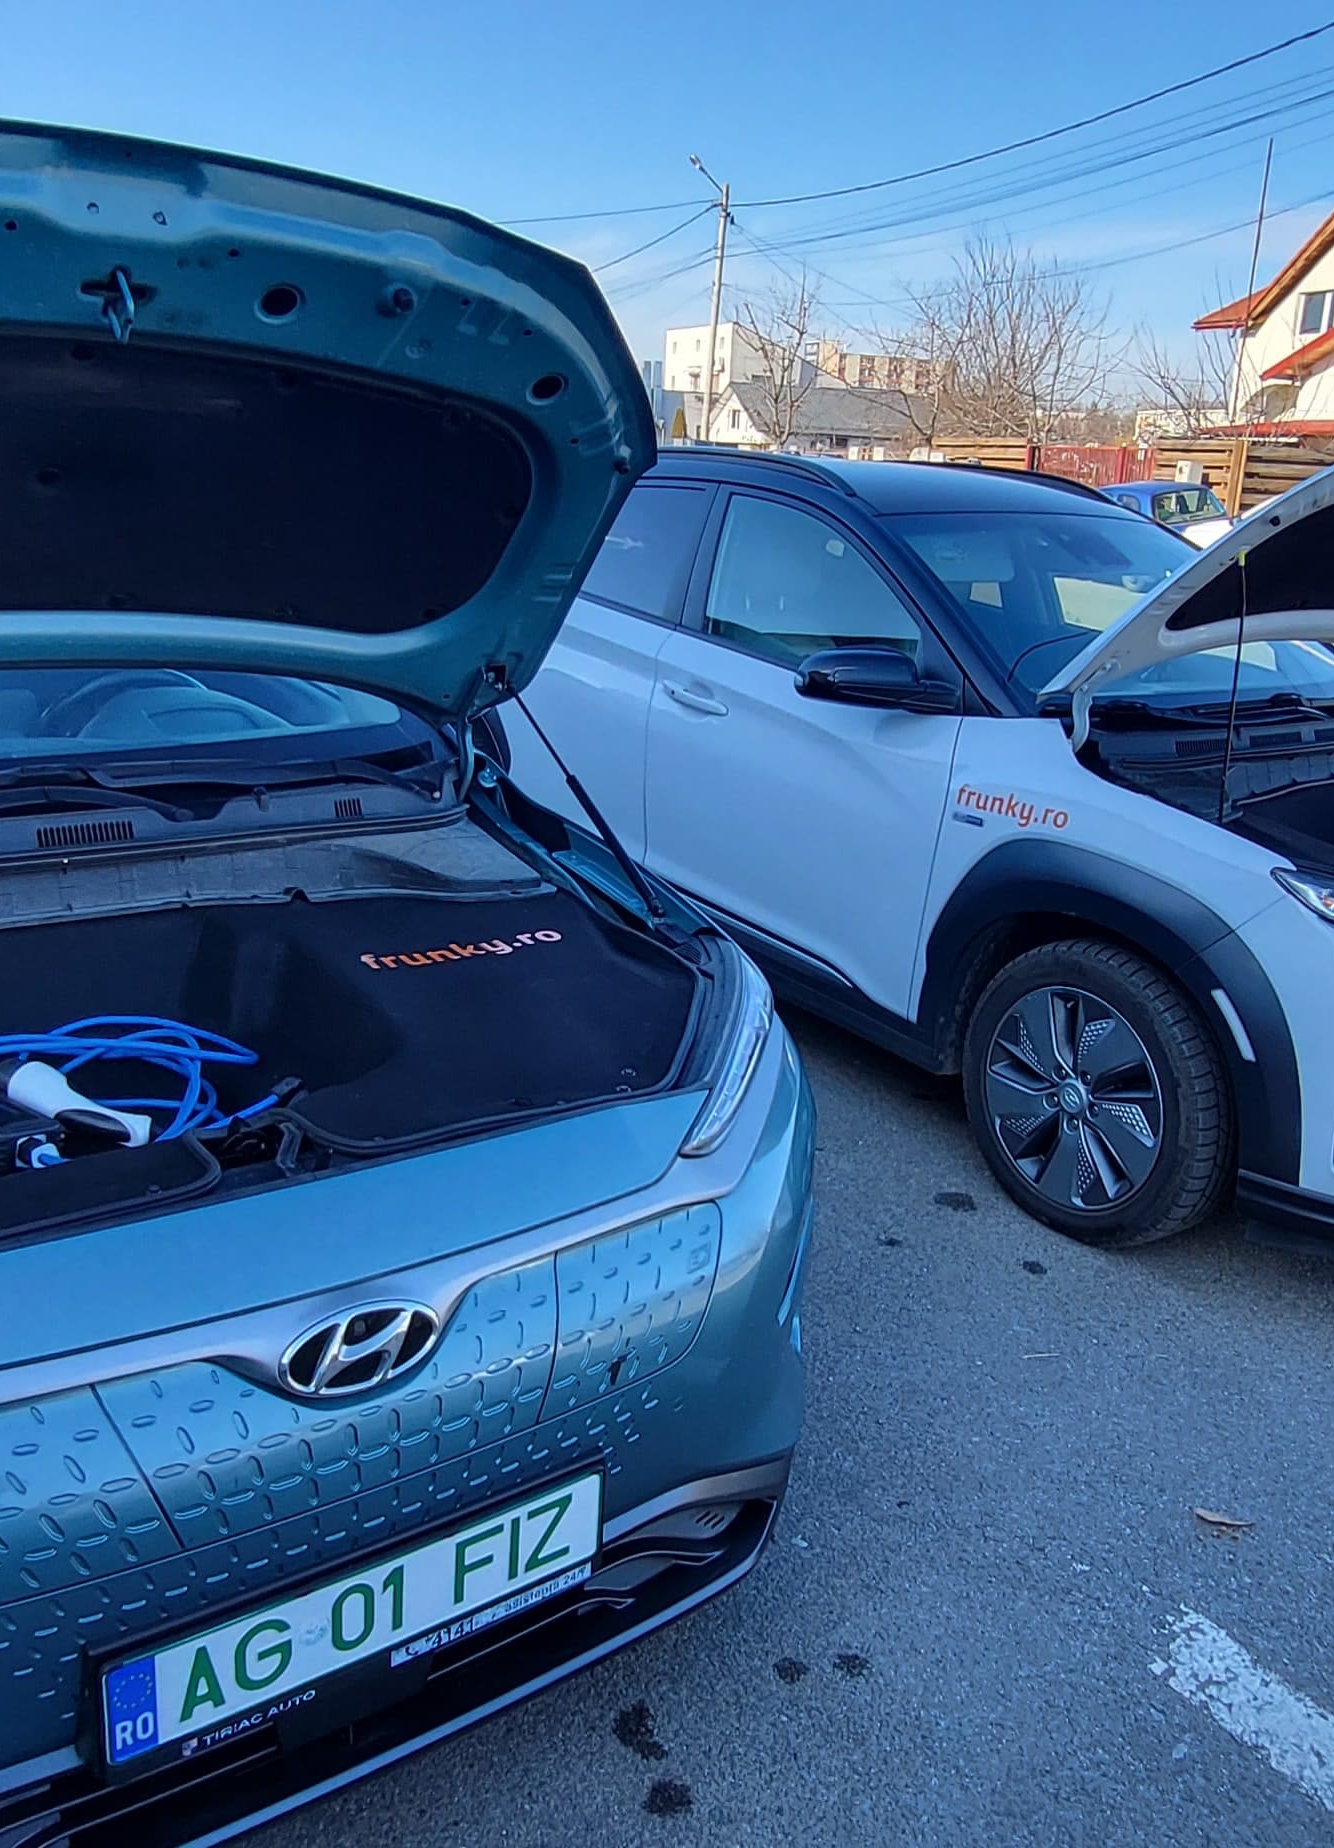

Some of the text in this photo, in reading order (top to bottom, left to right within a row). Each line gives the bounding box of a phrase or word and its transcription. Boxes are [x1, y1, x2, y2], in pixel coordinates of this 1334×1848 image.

[956, 785, 1068, 828] frunky.ro
[360, 929, 562, 969] frunky.ro
[180, 1493, 573, 1723] AG 01 FIZ
[267, 1689, 316, 1718] AUTO
[116, 1711, 155, 1751] RO
